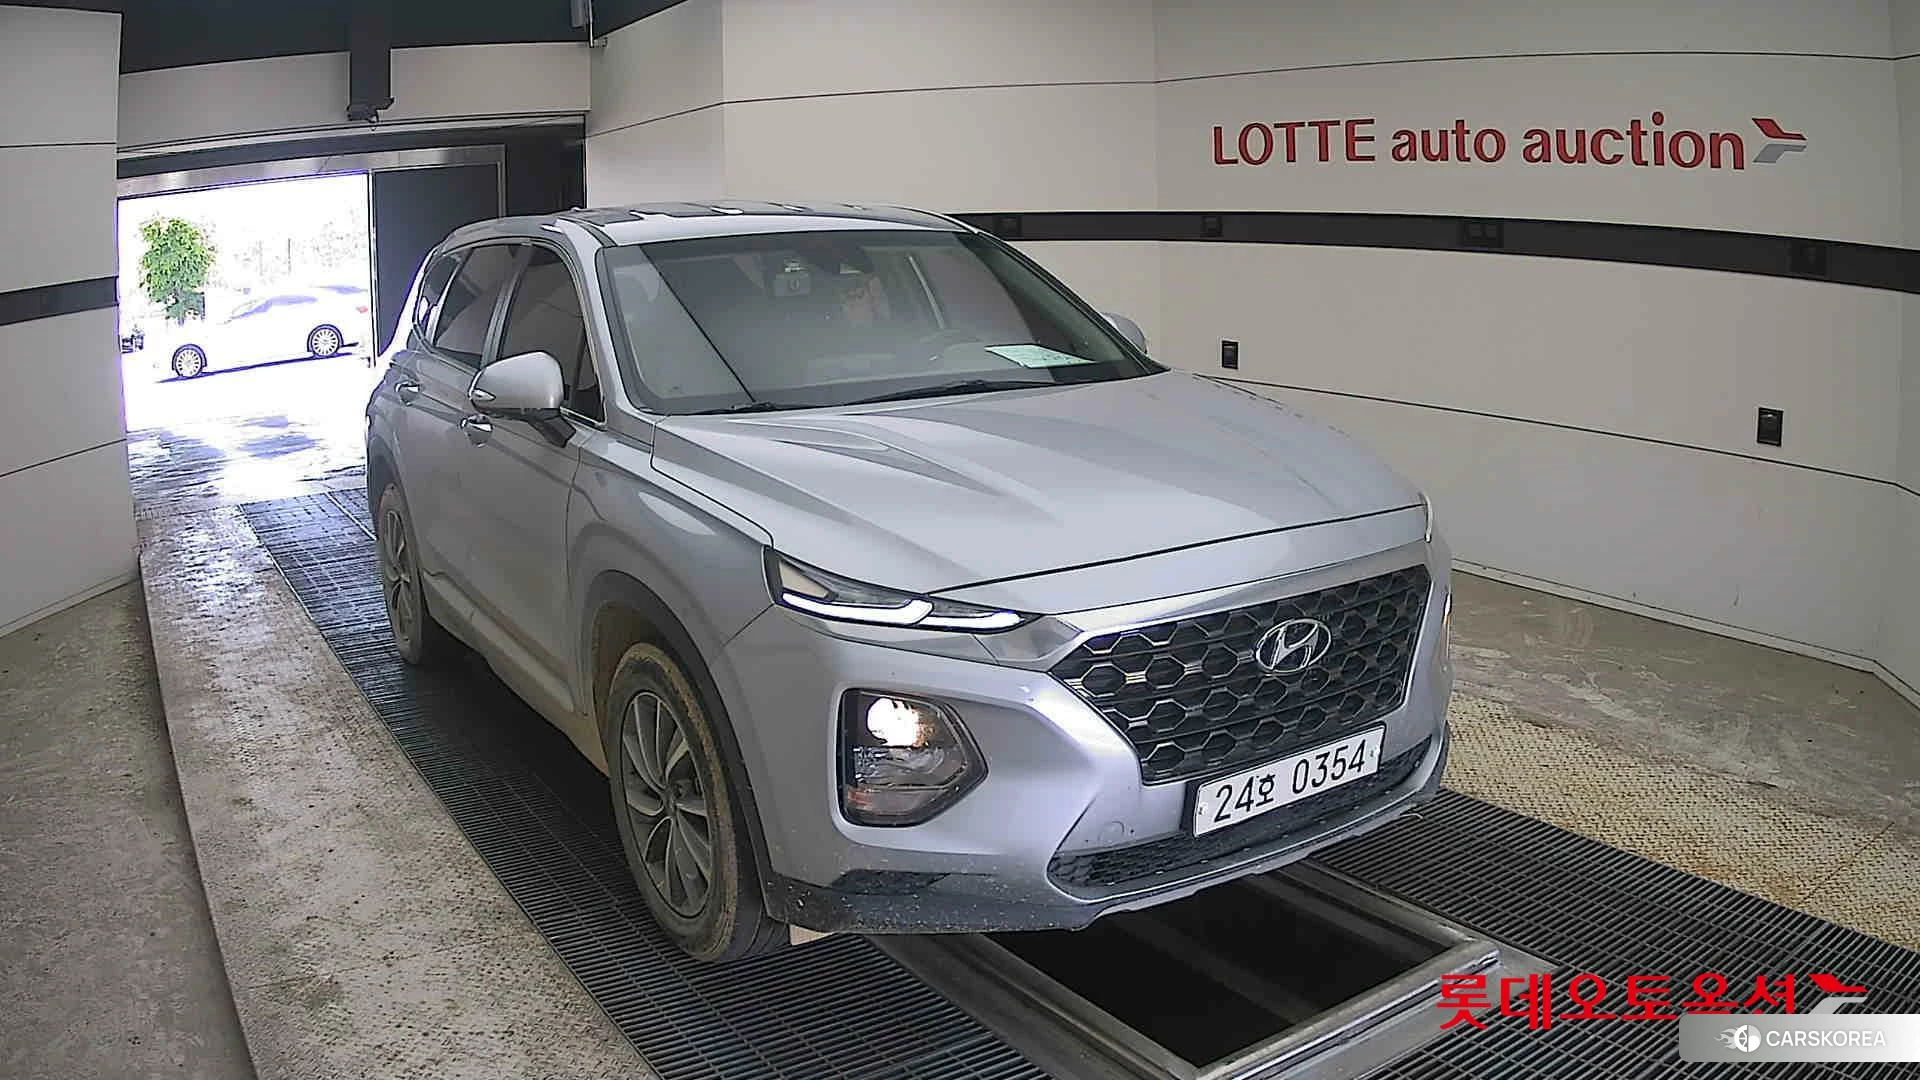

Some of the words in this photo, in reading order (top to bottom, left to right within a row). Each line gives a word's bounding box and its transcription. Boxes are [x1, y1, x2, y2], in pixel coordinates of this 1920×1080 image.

[1212, 118, 1376, 165] LOTTE
[1391, 118, 1507, 163] auto
[1521, 110, 1746, 170] auction
[1213, 774, 1276, 823] 24호
[1292, 739, 1367, 795] 0354
